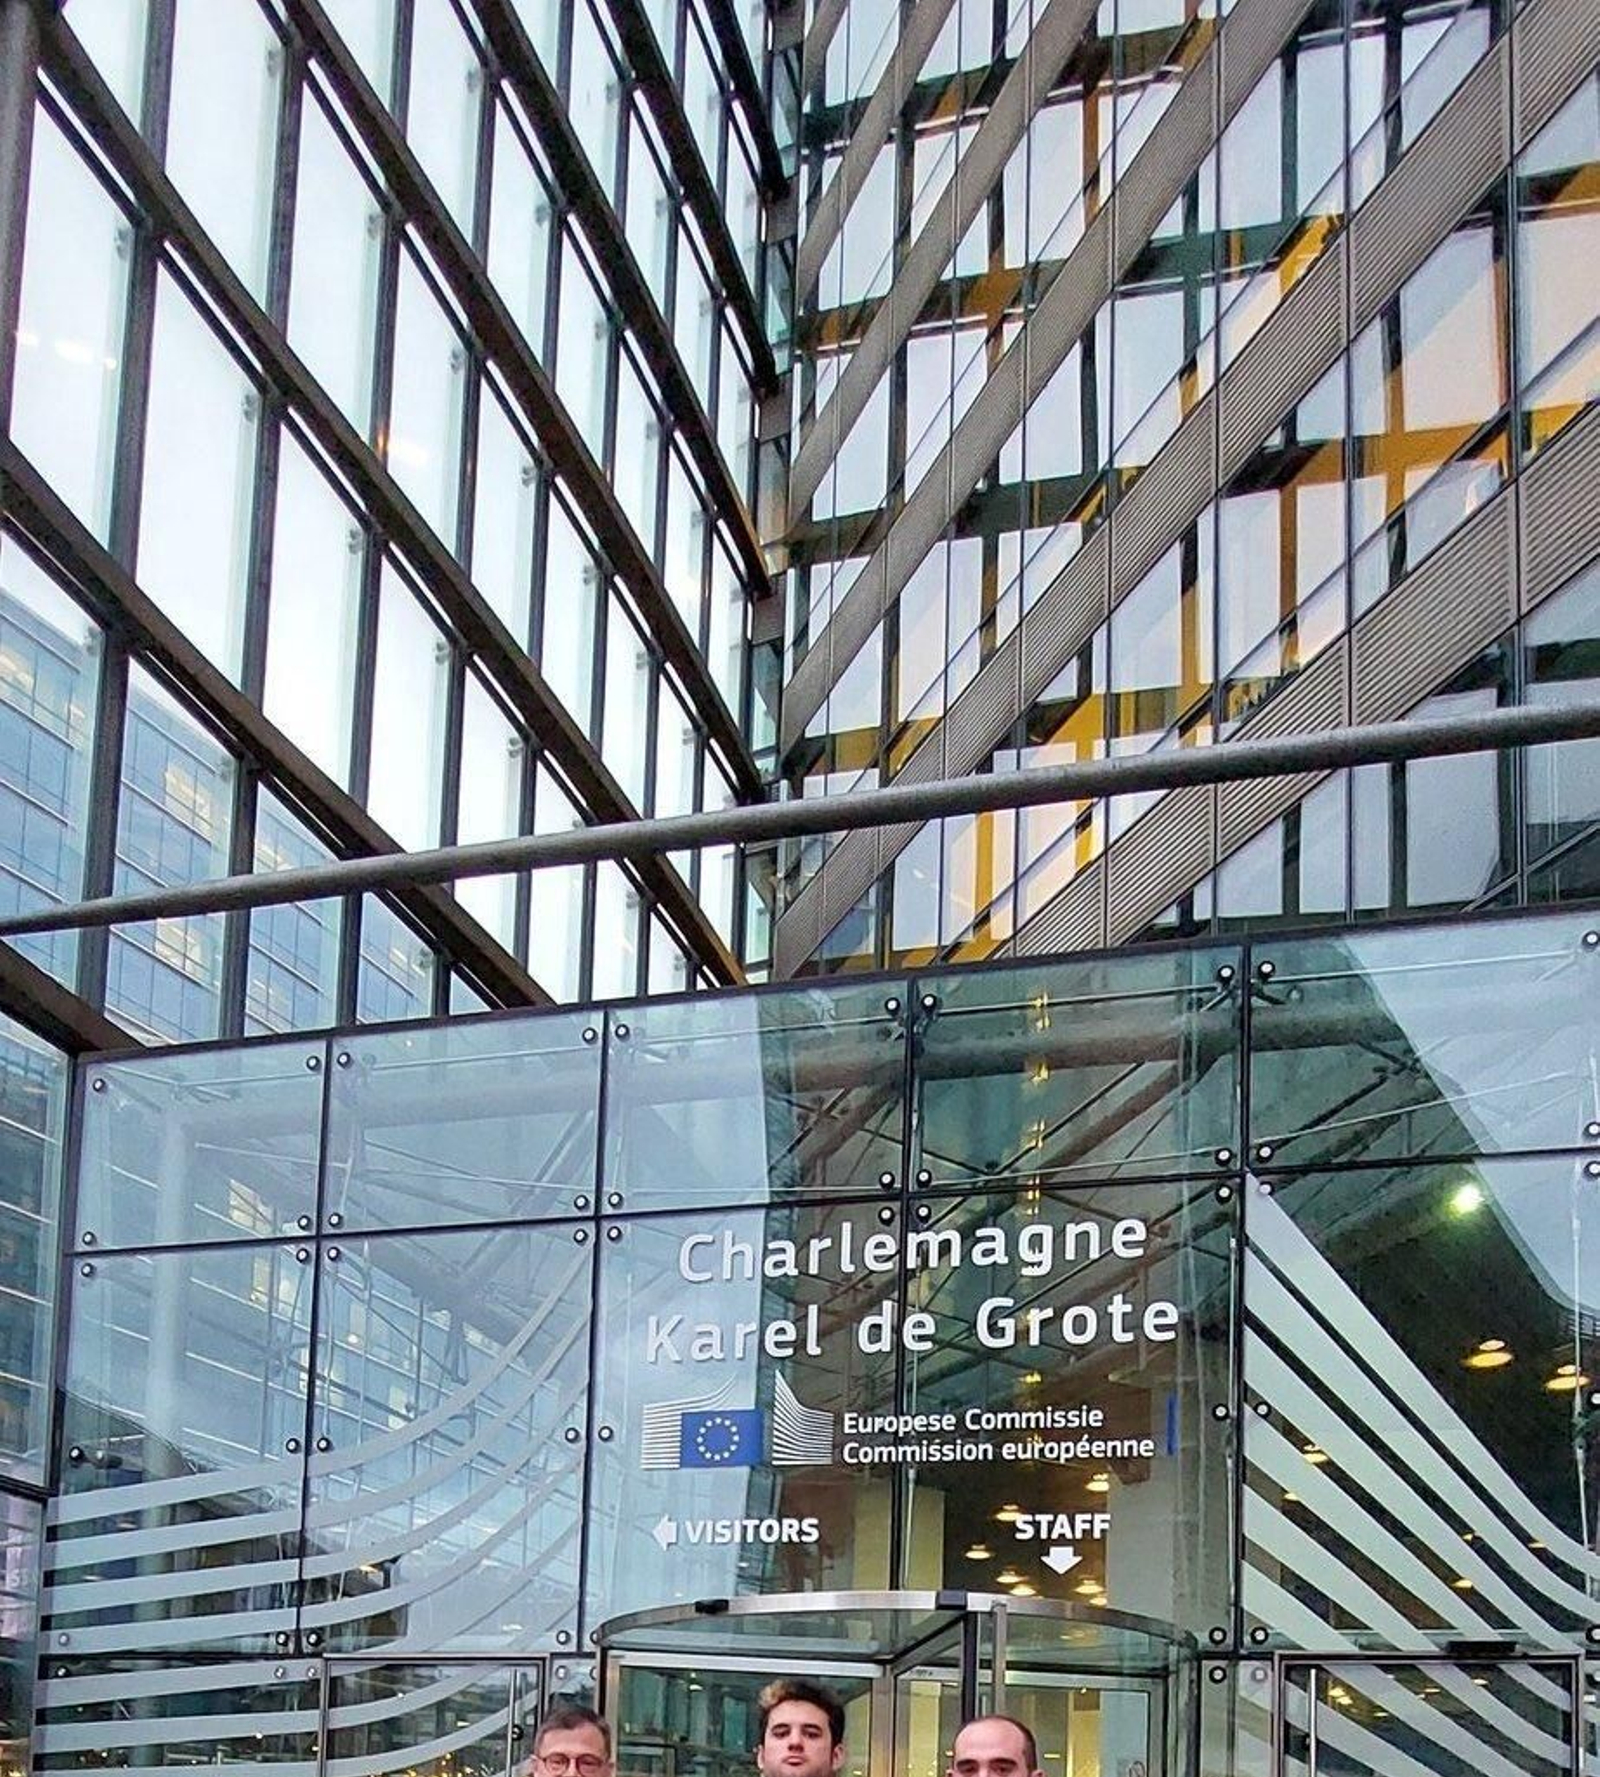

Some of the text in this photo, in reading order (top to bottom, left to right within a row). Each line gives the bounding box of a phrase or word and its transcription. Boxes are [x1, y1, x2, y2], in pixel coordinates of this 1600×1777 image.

[678, 1217, 1149, 1283] Charlemagne
[645, 1293, 1181, 1363] Karel de Grote
[843, 1405, 1104, 1437] Europese Commissie
[843, 1434, 1155, 1464] Commission européenne
[684, 1517, 820, 1544] VISITORS
[1014, 1513, 1111, 1540] STAFF
